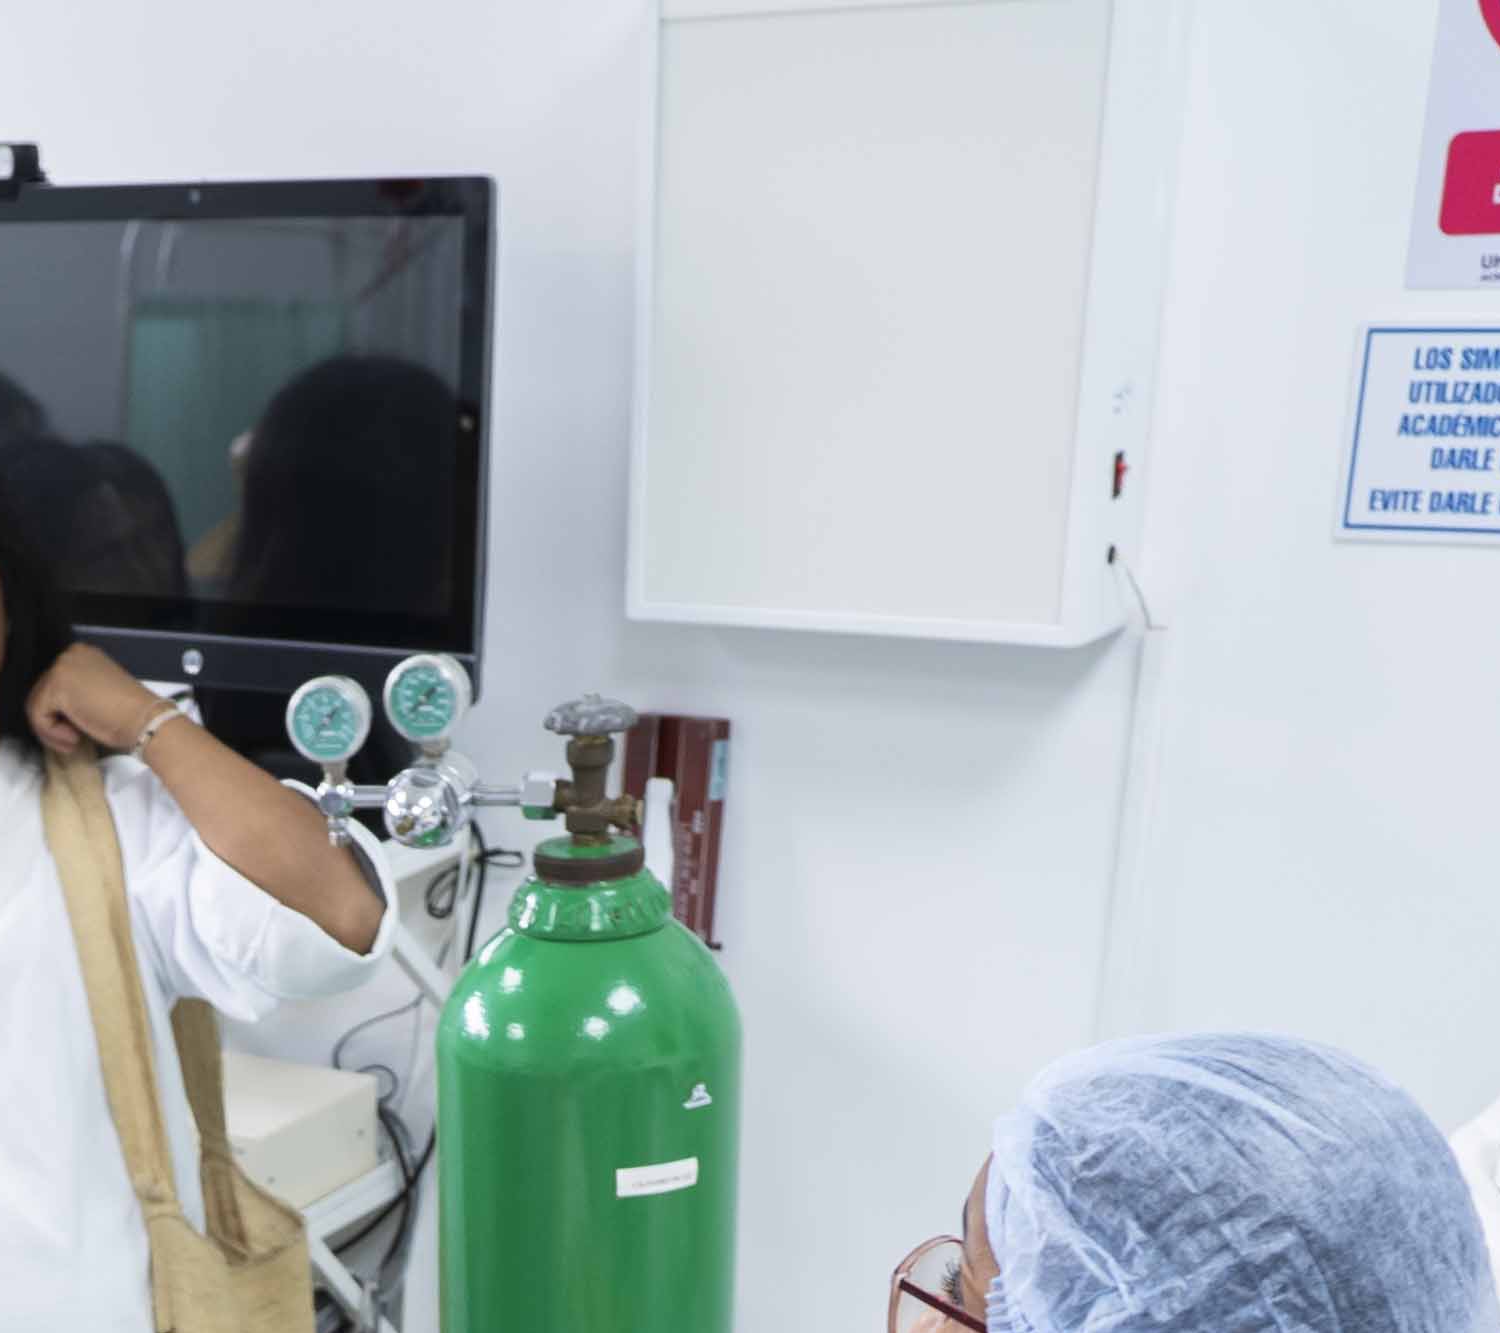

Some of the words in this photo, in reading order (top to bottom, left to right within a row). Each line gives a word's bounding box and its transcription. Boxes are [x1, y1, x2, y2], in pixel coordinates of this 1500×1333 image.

[1413, 347, 1452, 372] LOS
[1430, 448, 1494, 473] DARLE
[1368, 488, 1421, 513] EVITE
[1428, 490, 1493, 514] DARLE
